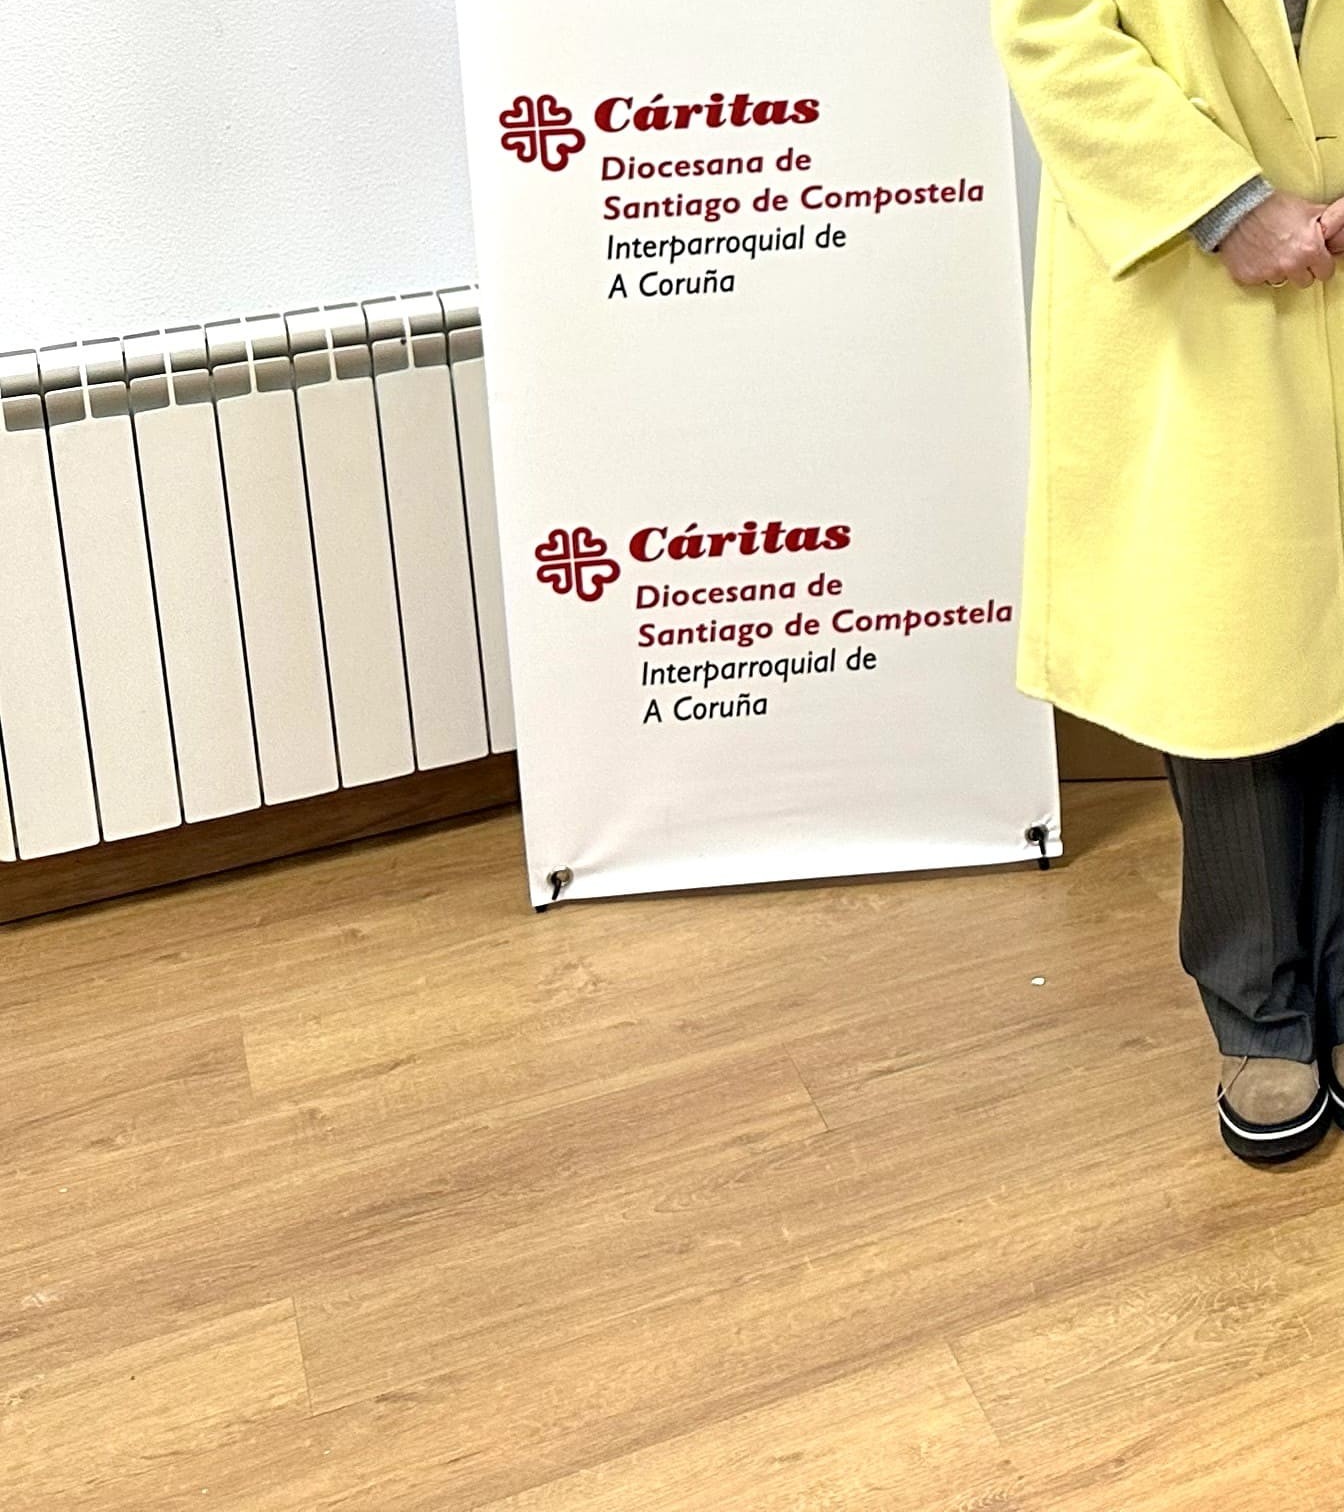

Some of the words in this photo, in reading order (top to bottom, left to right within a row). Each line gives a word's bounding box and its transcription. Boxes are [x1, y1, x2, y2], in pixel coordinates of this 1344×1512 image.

[593, 92, 820, 134] Cáritas
[600, 155, 764, 182] Diocesana
[775, 146, 812, 172] de
[603, 193, 741, 223] Santiago
[752, 187, 789, 213] de
[800, 177, 984, 215] Compostela
[607, 223, 805, 265] Interparroquial
[815, 222, 847, 249] de
[607, 273, 628, 300] A
[638, 268, 735, 298] Coruña
[628, 520, 851, 563] Cáritas
[635, 581, 796, 610] Diocesana
[807, 572, 843, 597] de
[637, 619, 774, 648] Santiago
[784, 612, 821, 637] de
[831, 599, 1013, 637] Compostela
[641, 647, 836, 689] Interparroquial
[845, 645, 877, 671] de
[642, 698, 663, 725] A
[673, 692, 768, 722] Coruña
